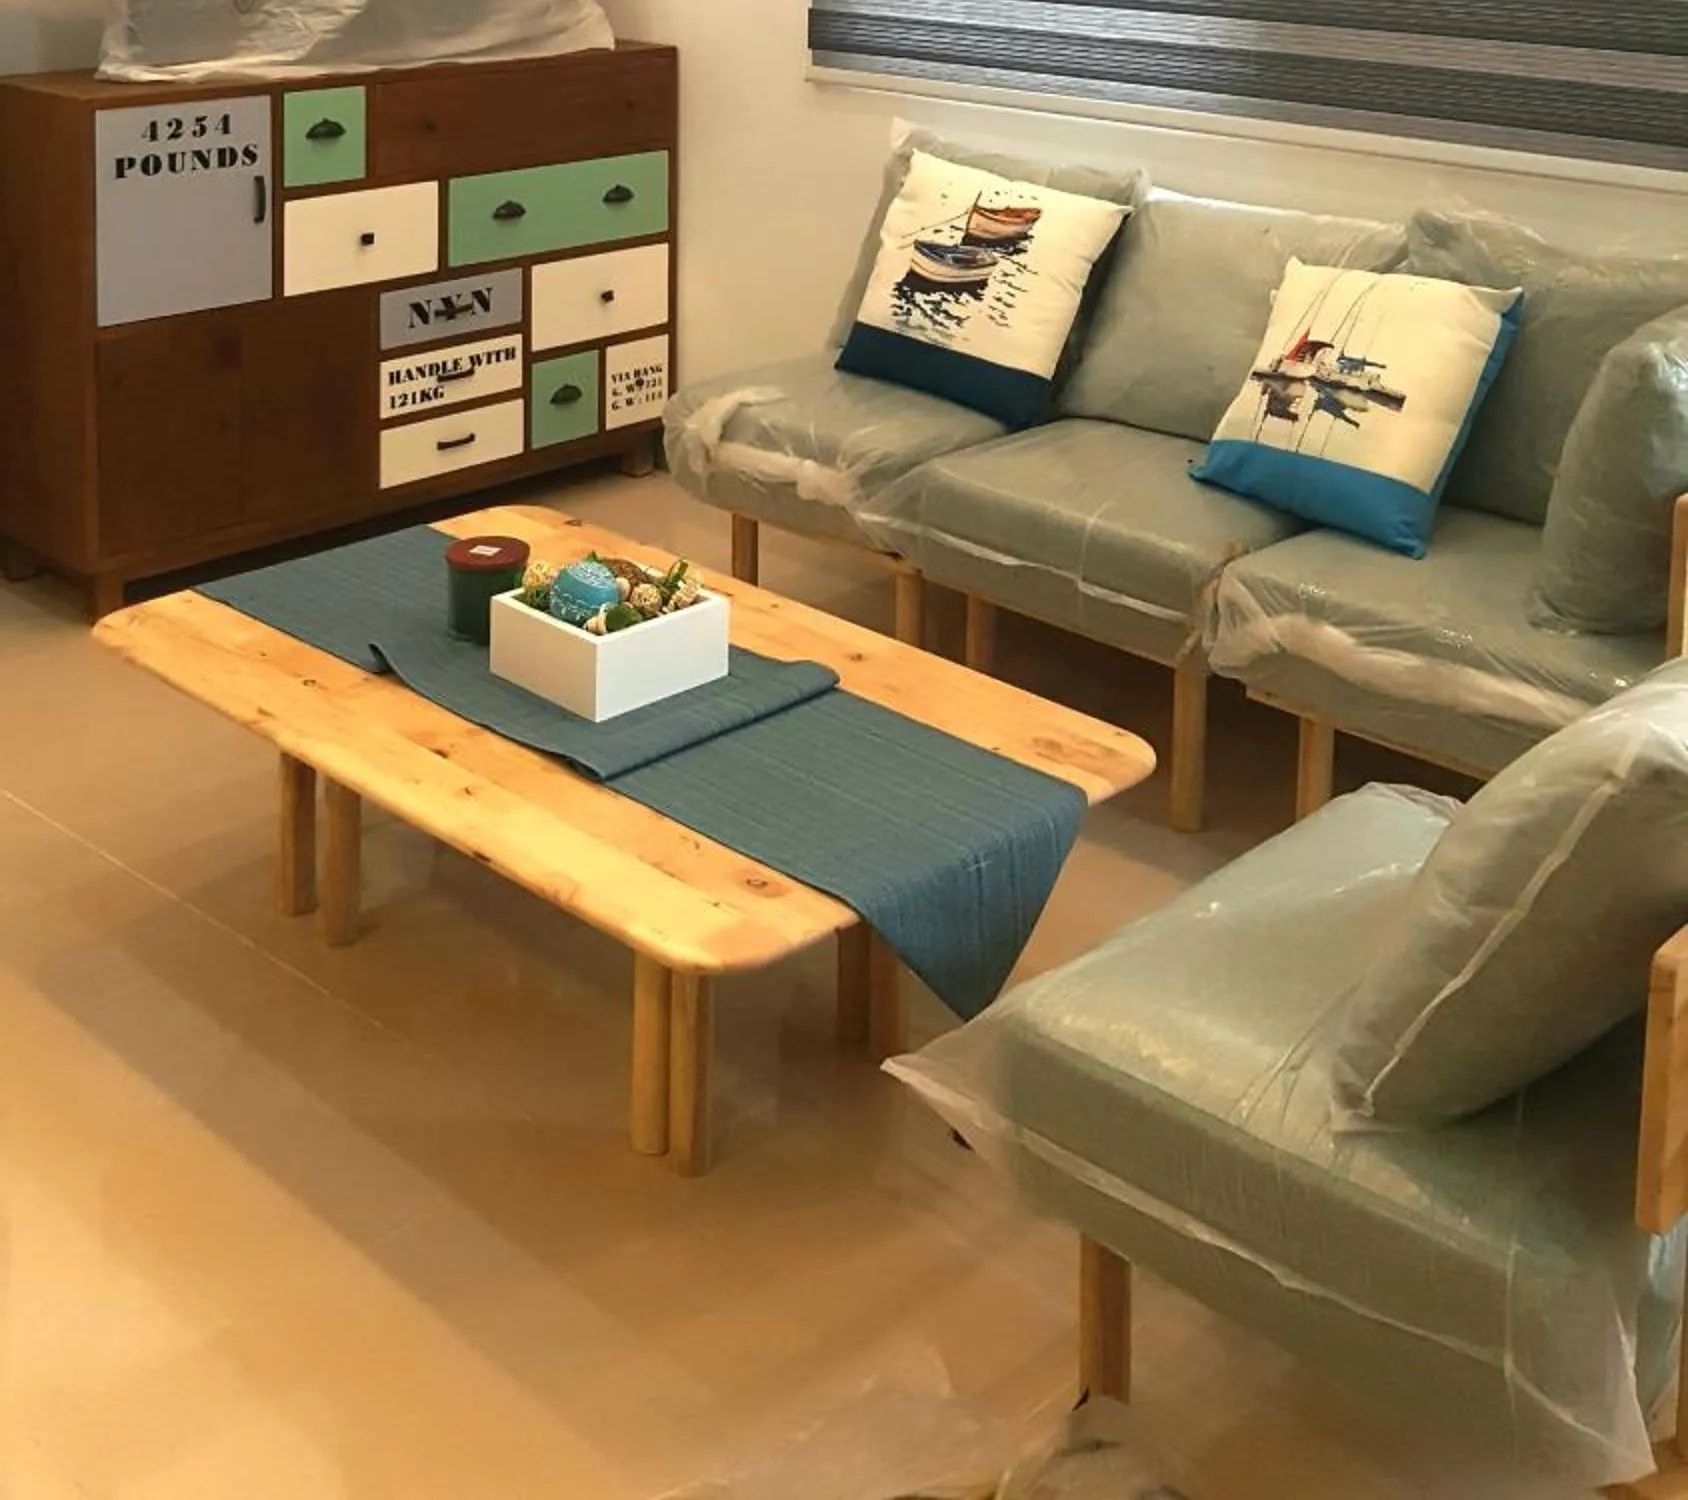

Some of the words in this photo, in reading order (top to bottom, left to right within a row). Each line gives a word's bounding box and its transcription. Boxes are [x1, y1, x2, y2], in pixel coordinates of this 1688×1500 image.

[141, 113, 231, 141] 4254
[114, 143, 258, 179] POUNDS
[389, 357, 463, 385] HANDLE
[468, 347, 516, 367] WITH
[390, 386, 445, 409] 121KG
